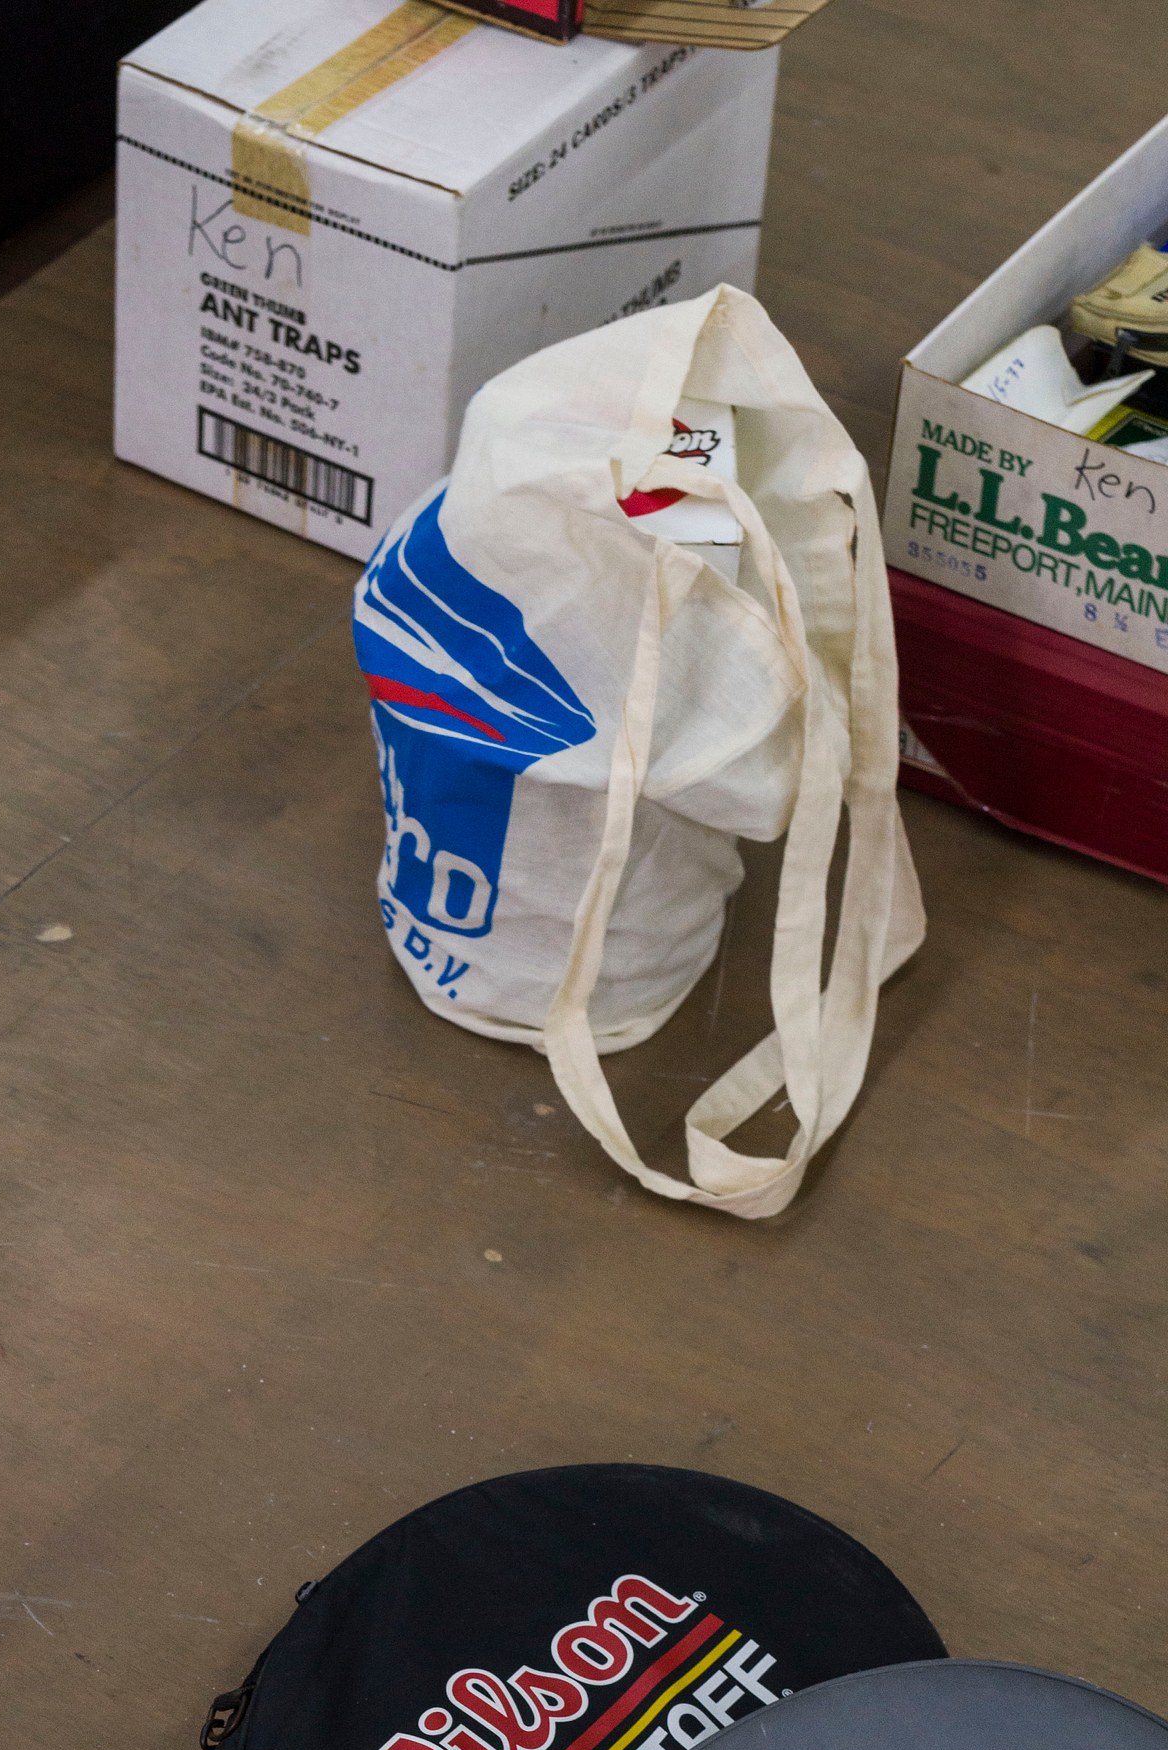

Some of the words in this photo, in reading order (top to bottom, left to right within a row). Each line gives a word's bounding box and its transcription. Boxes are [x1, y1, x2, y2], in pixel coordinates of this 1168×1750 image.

[187, 183, 303, 289] Ken
[199, 271, 249, 302] GREEN
[252, 292, 307, 326] THUMB
[199, 292, 260, 333] ANT
[268, 316, 362, 375] TRAPS
[200, 344, 237, 370] Code
[200, 379, 228, 402] EPA
[200, 362, 235, 387] Size:
[281, 396, 316, 421] Pack
[921, 417, 994, 465] MADE
[998, 448, 1035, 478] BY
[1074, 447, 1157, 515] Ken
[911, 443, 1168, 590] L.L.Bea
